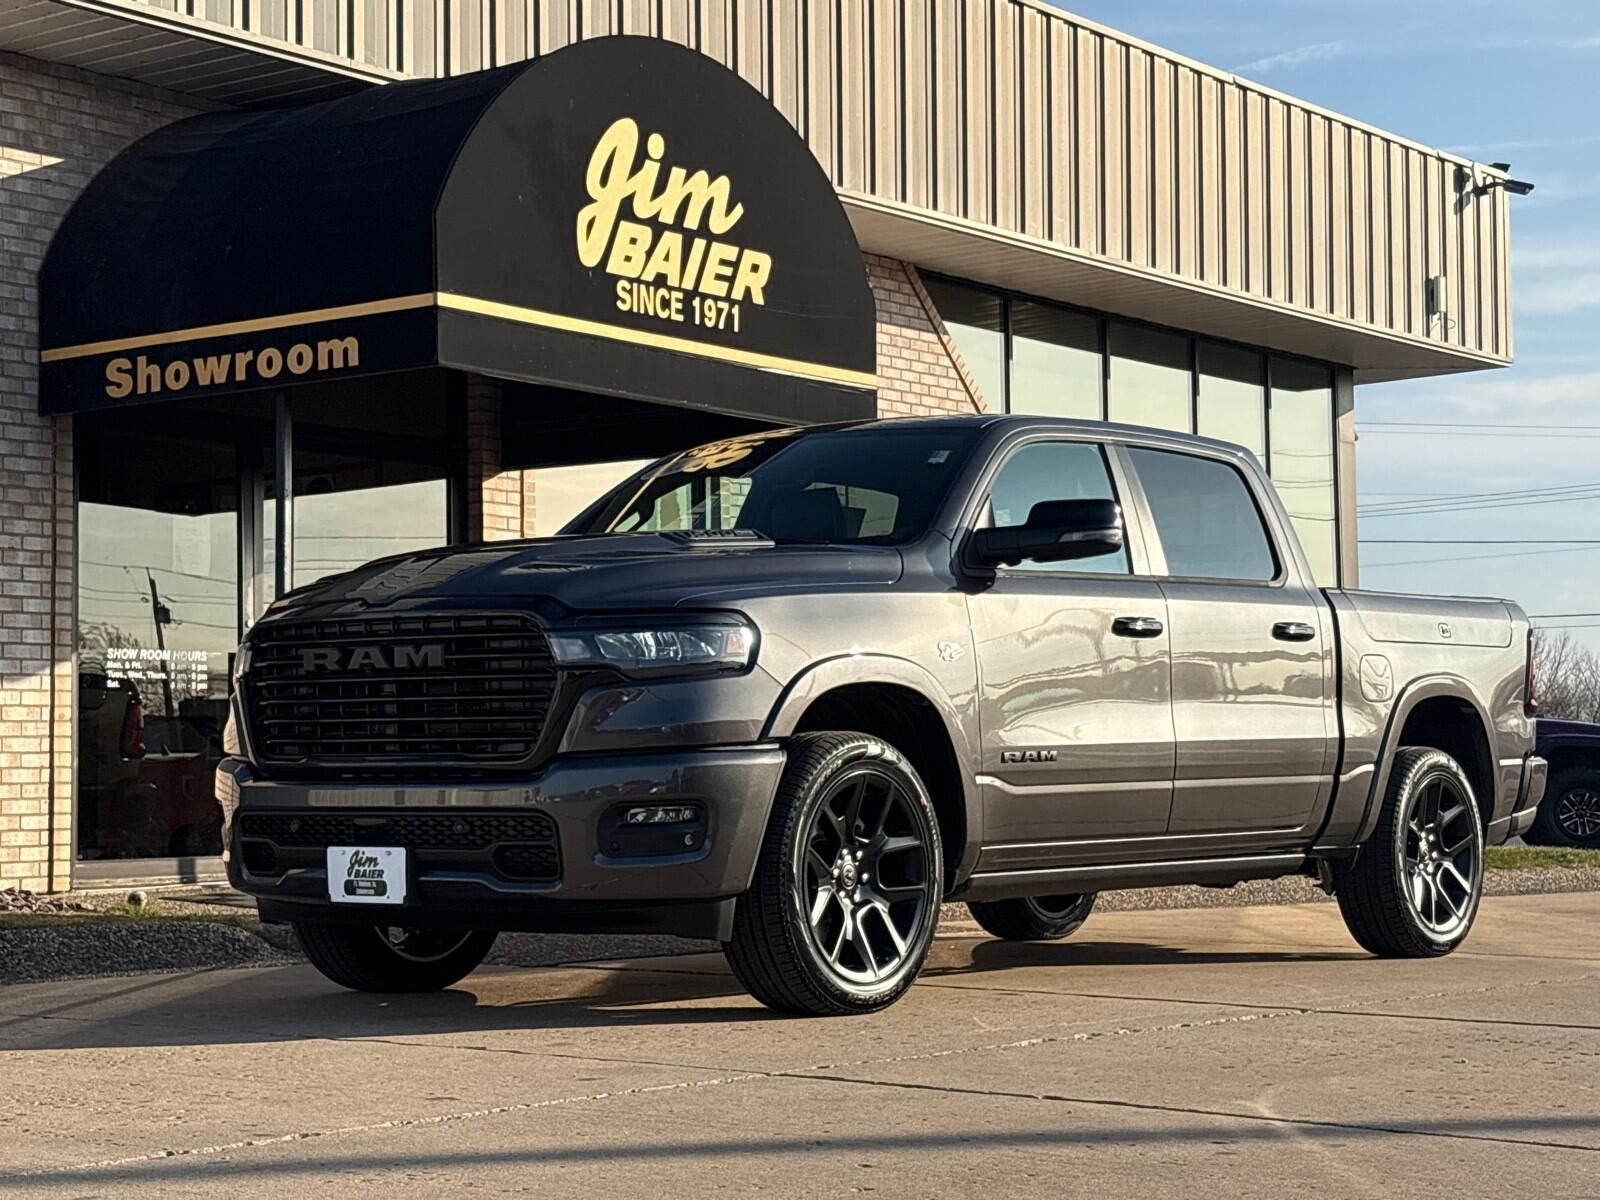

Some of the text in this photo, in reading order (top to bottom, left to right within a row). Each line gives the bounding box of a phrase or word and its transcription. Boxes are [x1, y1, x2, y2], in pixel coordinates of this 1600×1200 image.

[576, 117, 744, 268] Jim
[605, 220, 772, 306] BAIER
[616, 279, 741, 333] SINCE 1971
[104, 336, 360, 399] Showroom
[106, 648, 208, 662] SHOW ROOM HOURS
[298, 643, 445, 673] RAM
[1000, 750, 1058, 764] RAM
[347, 849, 380, 878] Jim
[354, 869, 385, 879] BAIER
